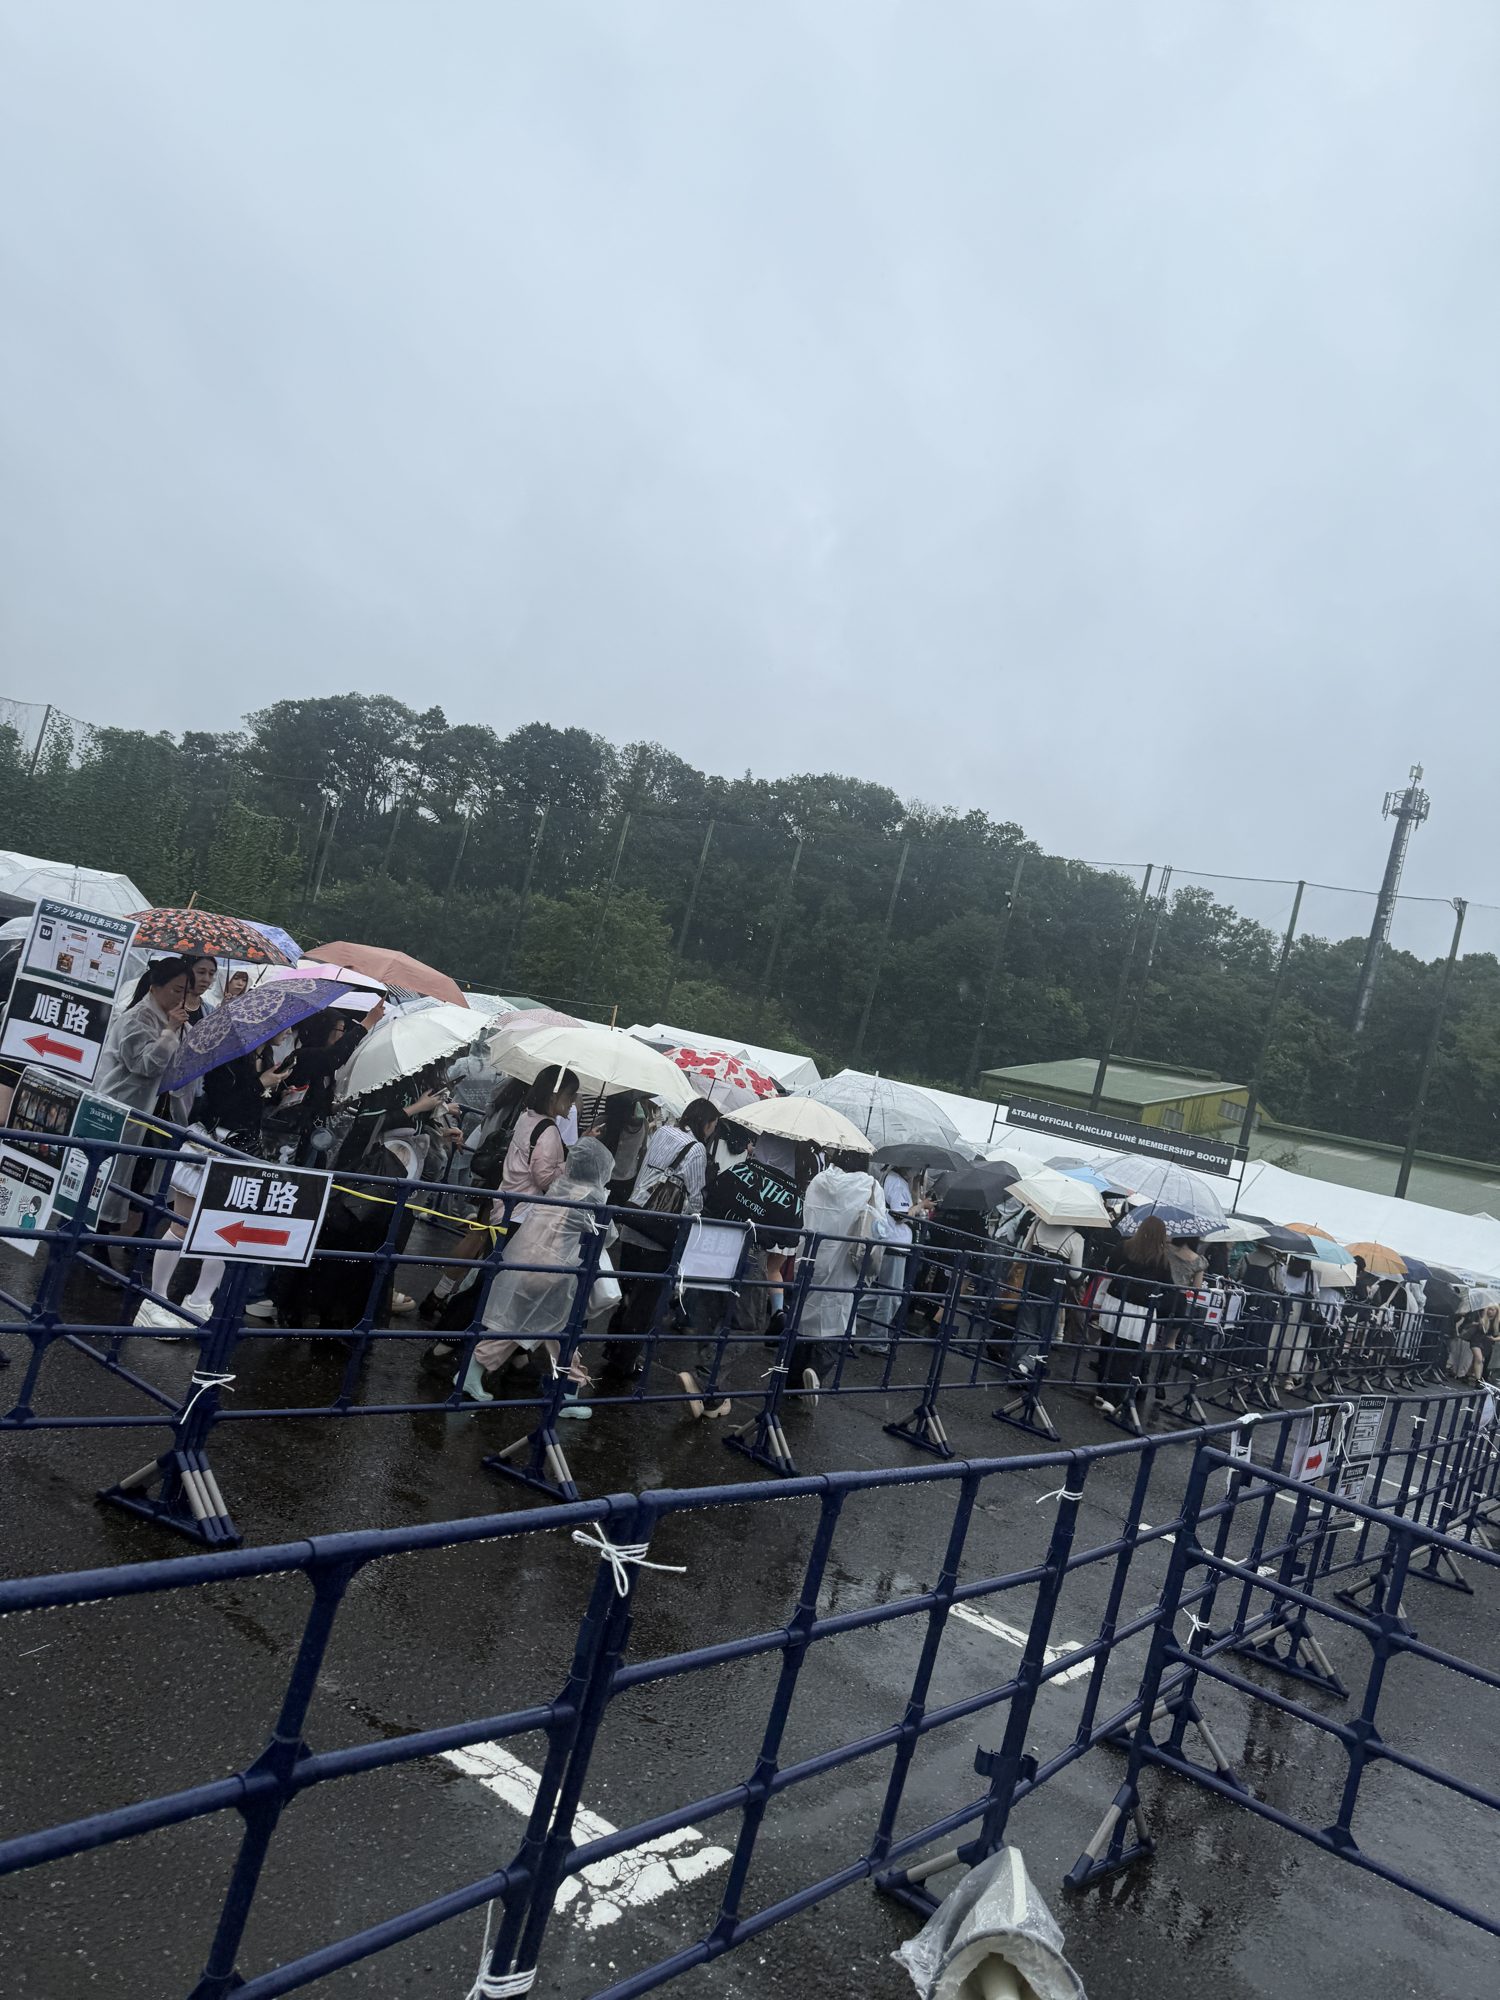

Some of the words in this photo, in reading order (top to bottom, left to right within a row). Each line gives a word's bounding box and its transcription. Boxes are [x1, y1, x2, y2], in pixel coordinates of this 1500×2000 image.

[30, 993, 91, 1035] 順路
[1011, 1108, 1038, 1120] &TEAM
[1039, 1115, 1074, 1129] OFFICIAL
[1075, 1123, 1113, 1138] FANCLUB
[1138, 1138, 1195, 1157] MEMBERSHIP
[1196, 1151, 1228, 1165] BOOTH
[261, 1170, 279, 1179] Rote
[759, 1175, 795, 1209] THE
[223, 1175, 299, 1215] 順路
[735, 1192, 768, 1217] ENCORE
